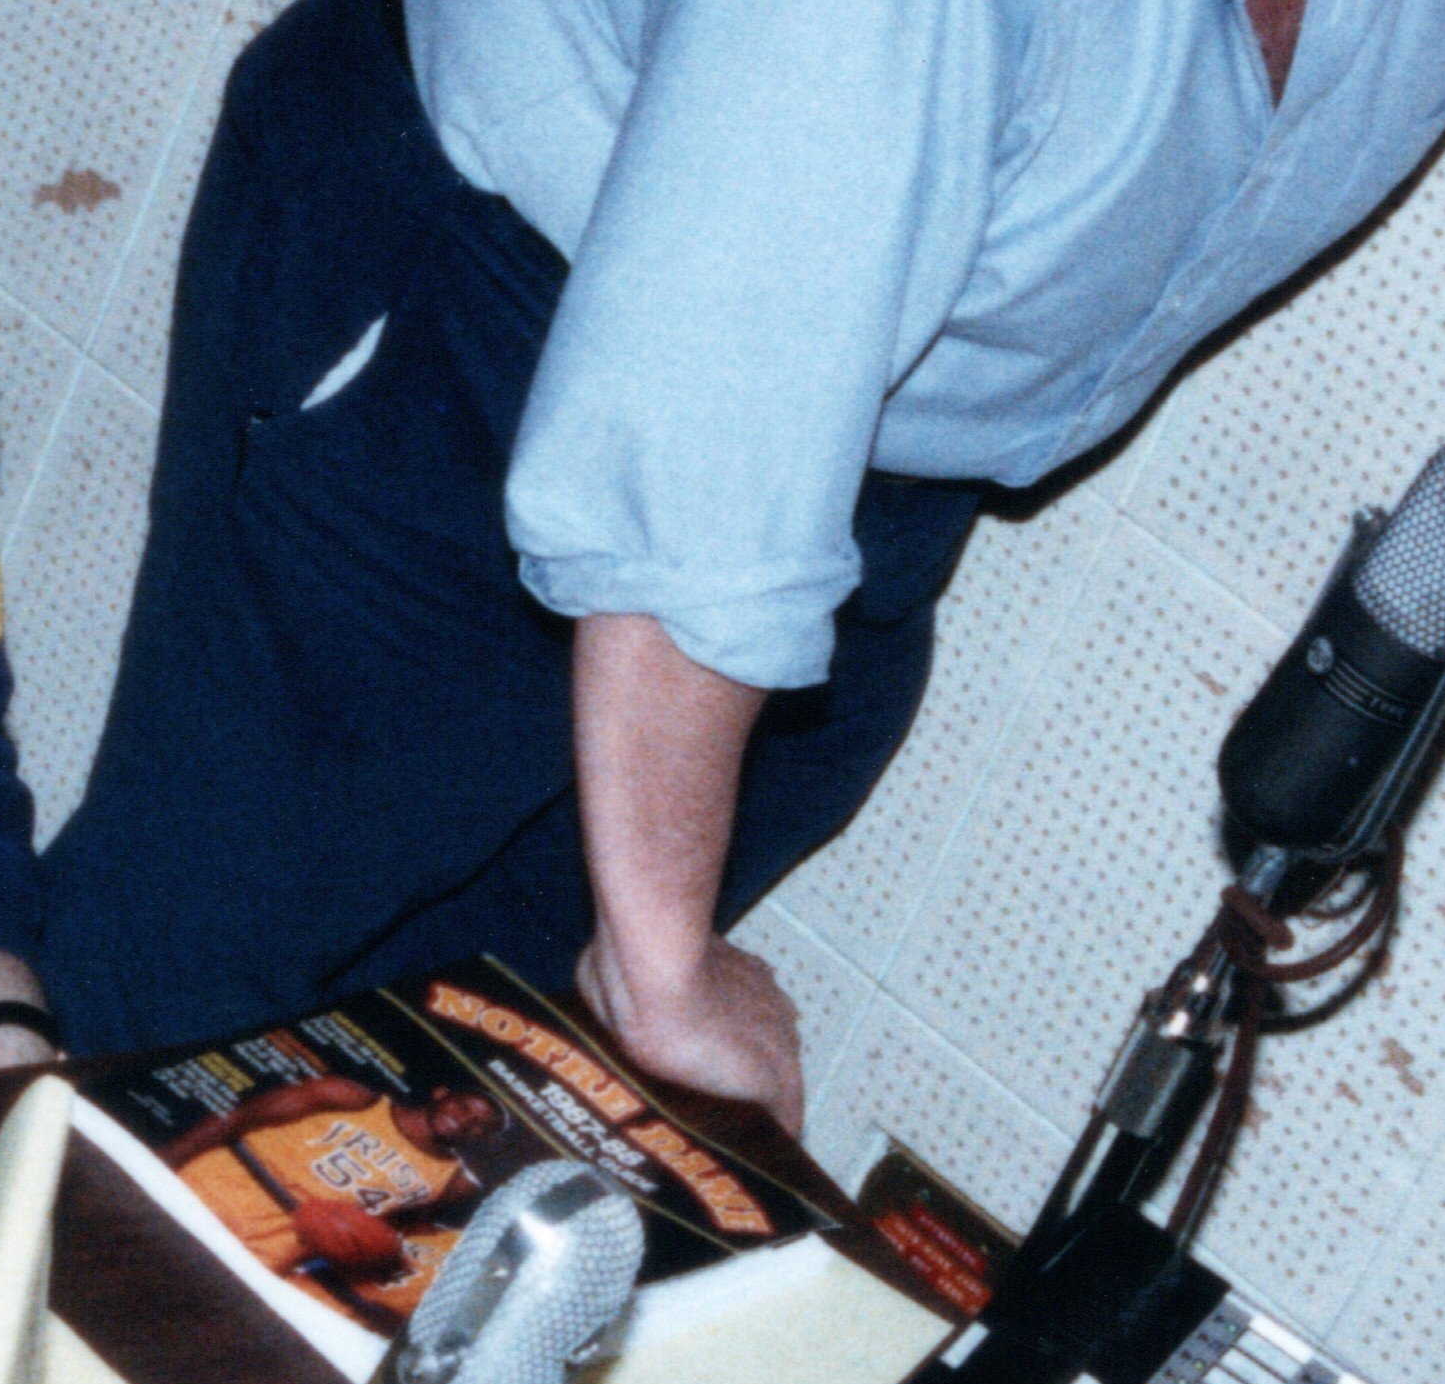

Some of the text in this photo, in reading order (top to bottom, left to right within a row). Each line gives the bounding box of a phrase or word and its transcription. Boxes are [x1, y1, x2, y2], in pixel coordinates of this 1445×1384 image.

[429, 983, 645, 1122] NOTRE
[624, 1121, 773, 1233] DAME
[488, 1059, 595, 1157] BASKETBALL
[541, 1083, 646, 1166] 1987-88
[313, 1146, 397, 1215] 54
